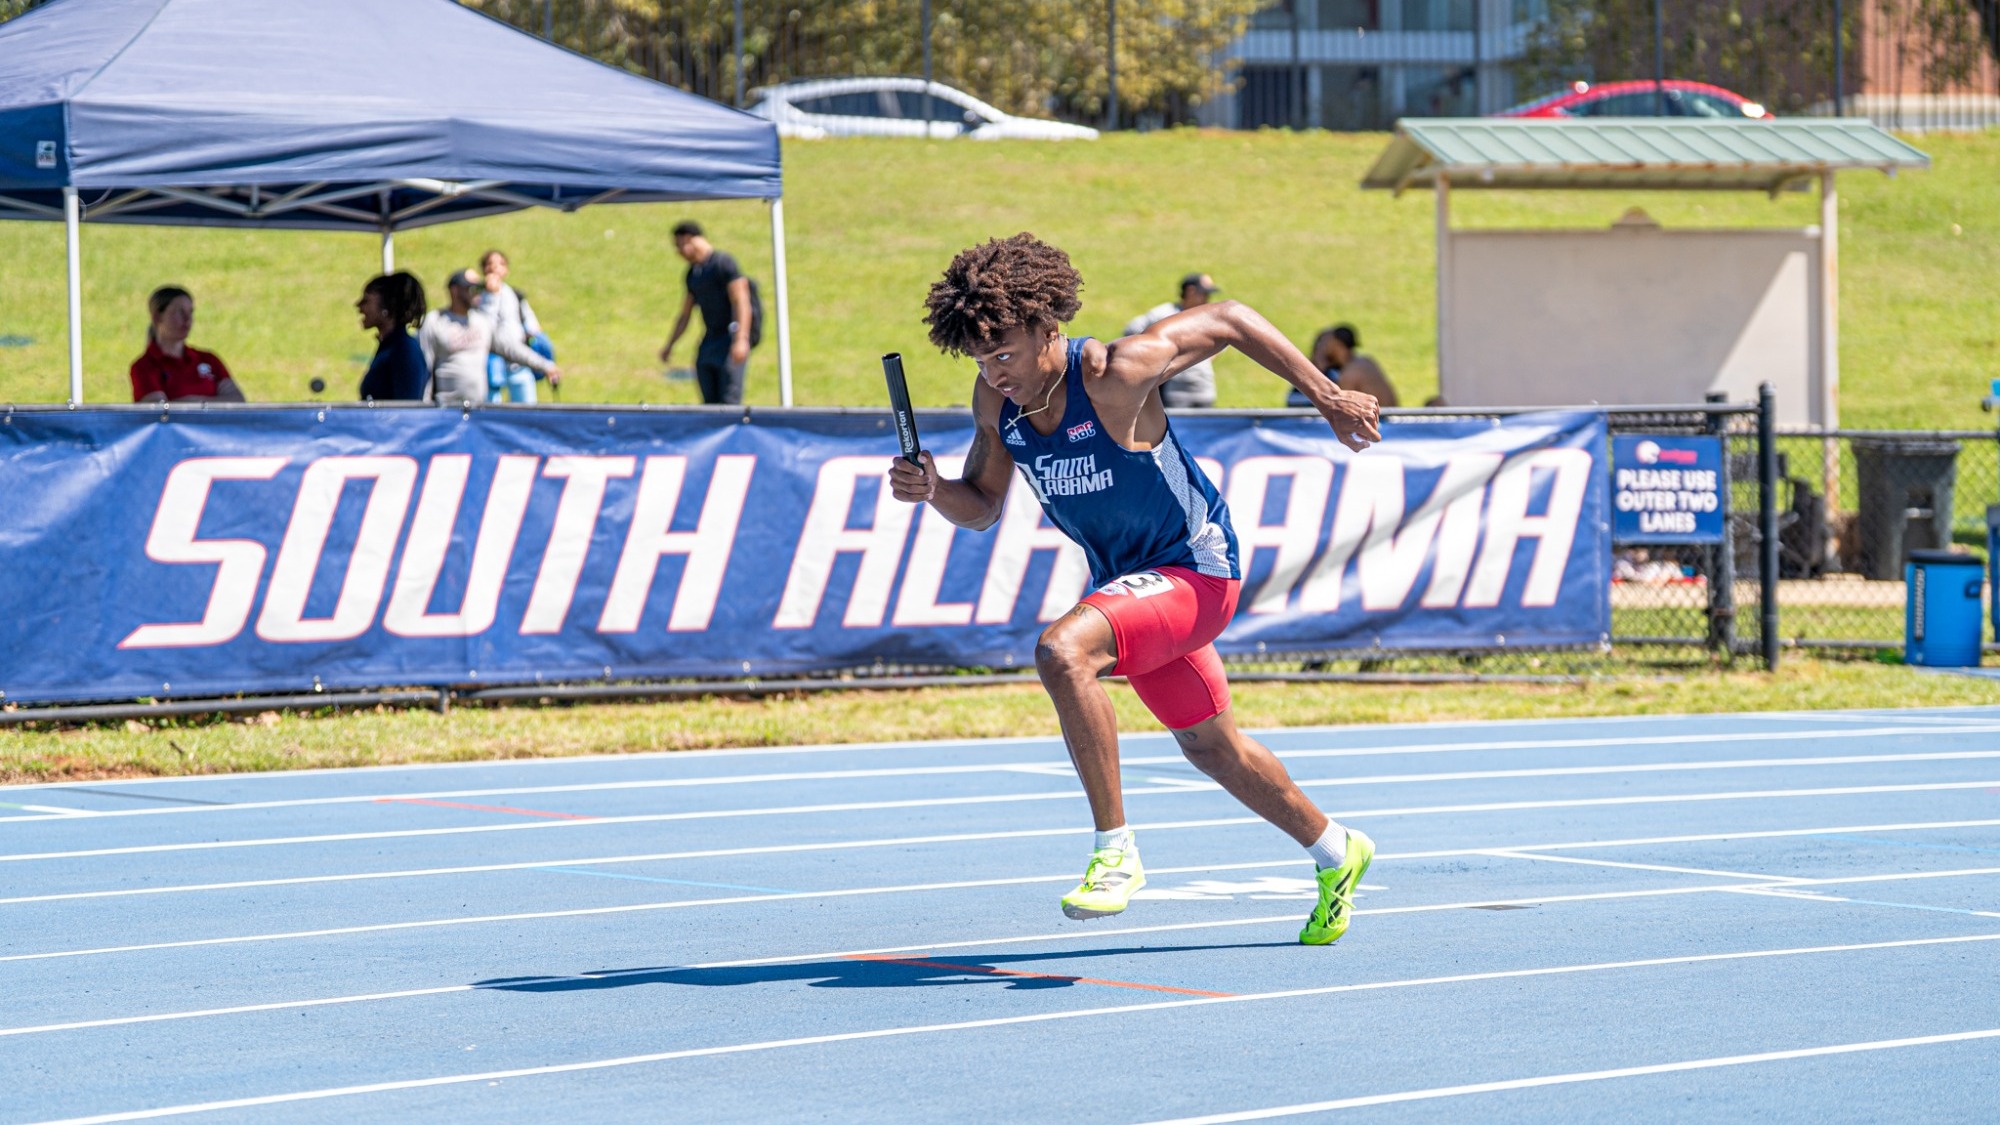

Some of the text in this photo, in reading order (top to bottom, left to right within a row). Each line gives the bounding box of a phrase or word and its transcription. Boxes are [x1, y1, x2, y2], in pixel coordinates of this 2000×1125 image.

[898, 410, 914, 453] Rekortan
[1035, 454, 1097, 480] SOUTH
[1617, 469, 1717, 490] PLEASE USE
[1616, 490, 1718, 512] OUTER TWO
[1640, 511, 1696, 533] LANES
[116, 448, 1593, 649] SOUTH ALAAMA
